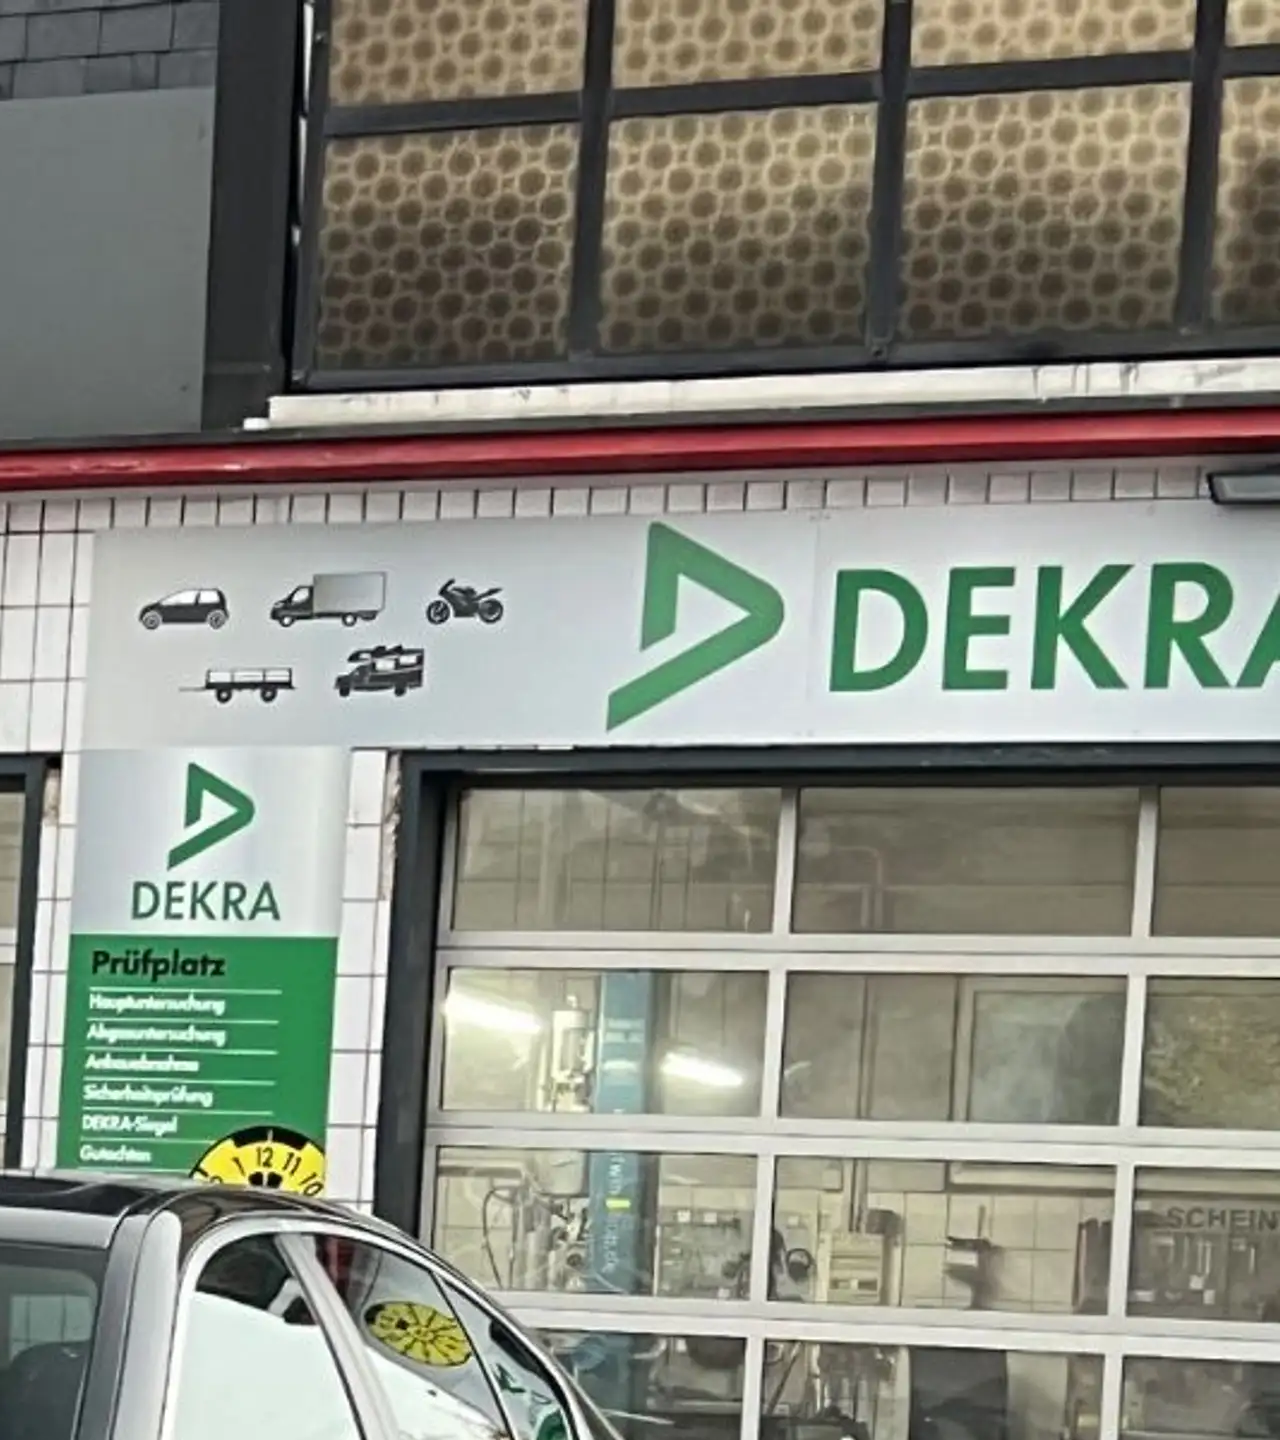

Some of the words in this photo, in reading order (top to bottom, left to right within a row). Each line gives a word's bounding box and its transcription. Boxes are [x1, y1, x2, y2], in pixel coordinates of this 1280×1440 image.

[131, 881, 281, 921] DEKRA
[91, 948, 226, 983] Prüfplatz
[255, 1147, 274, 1168] 12
